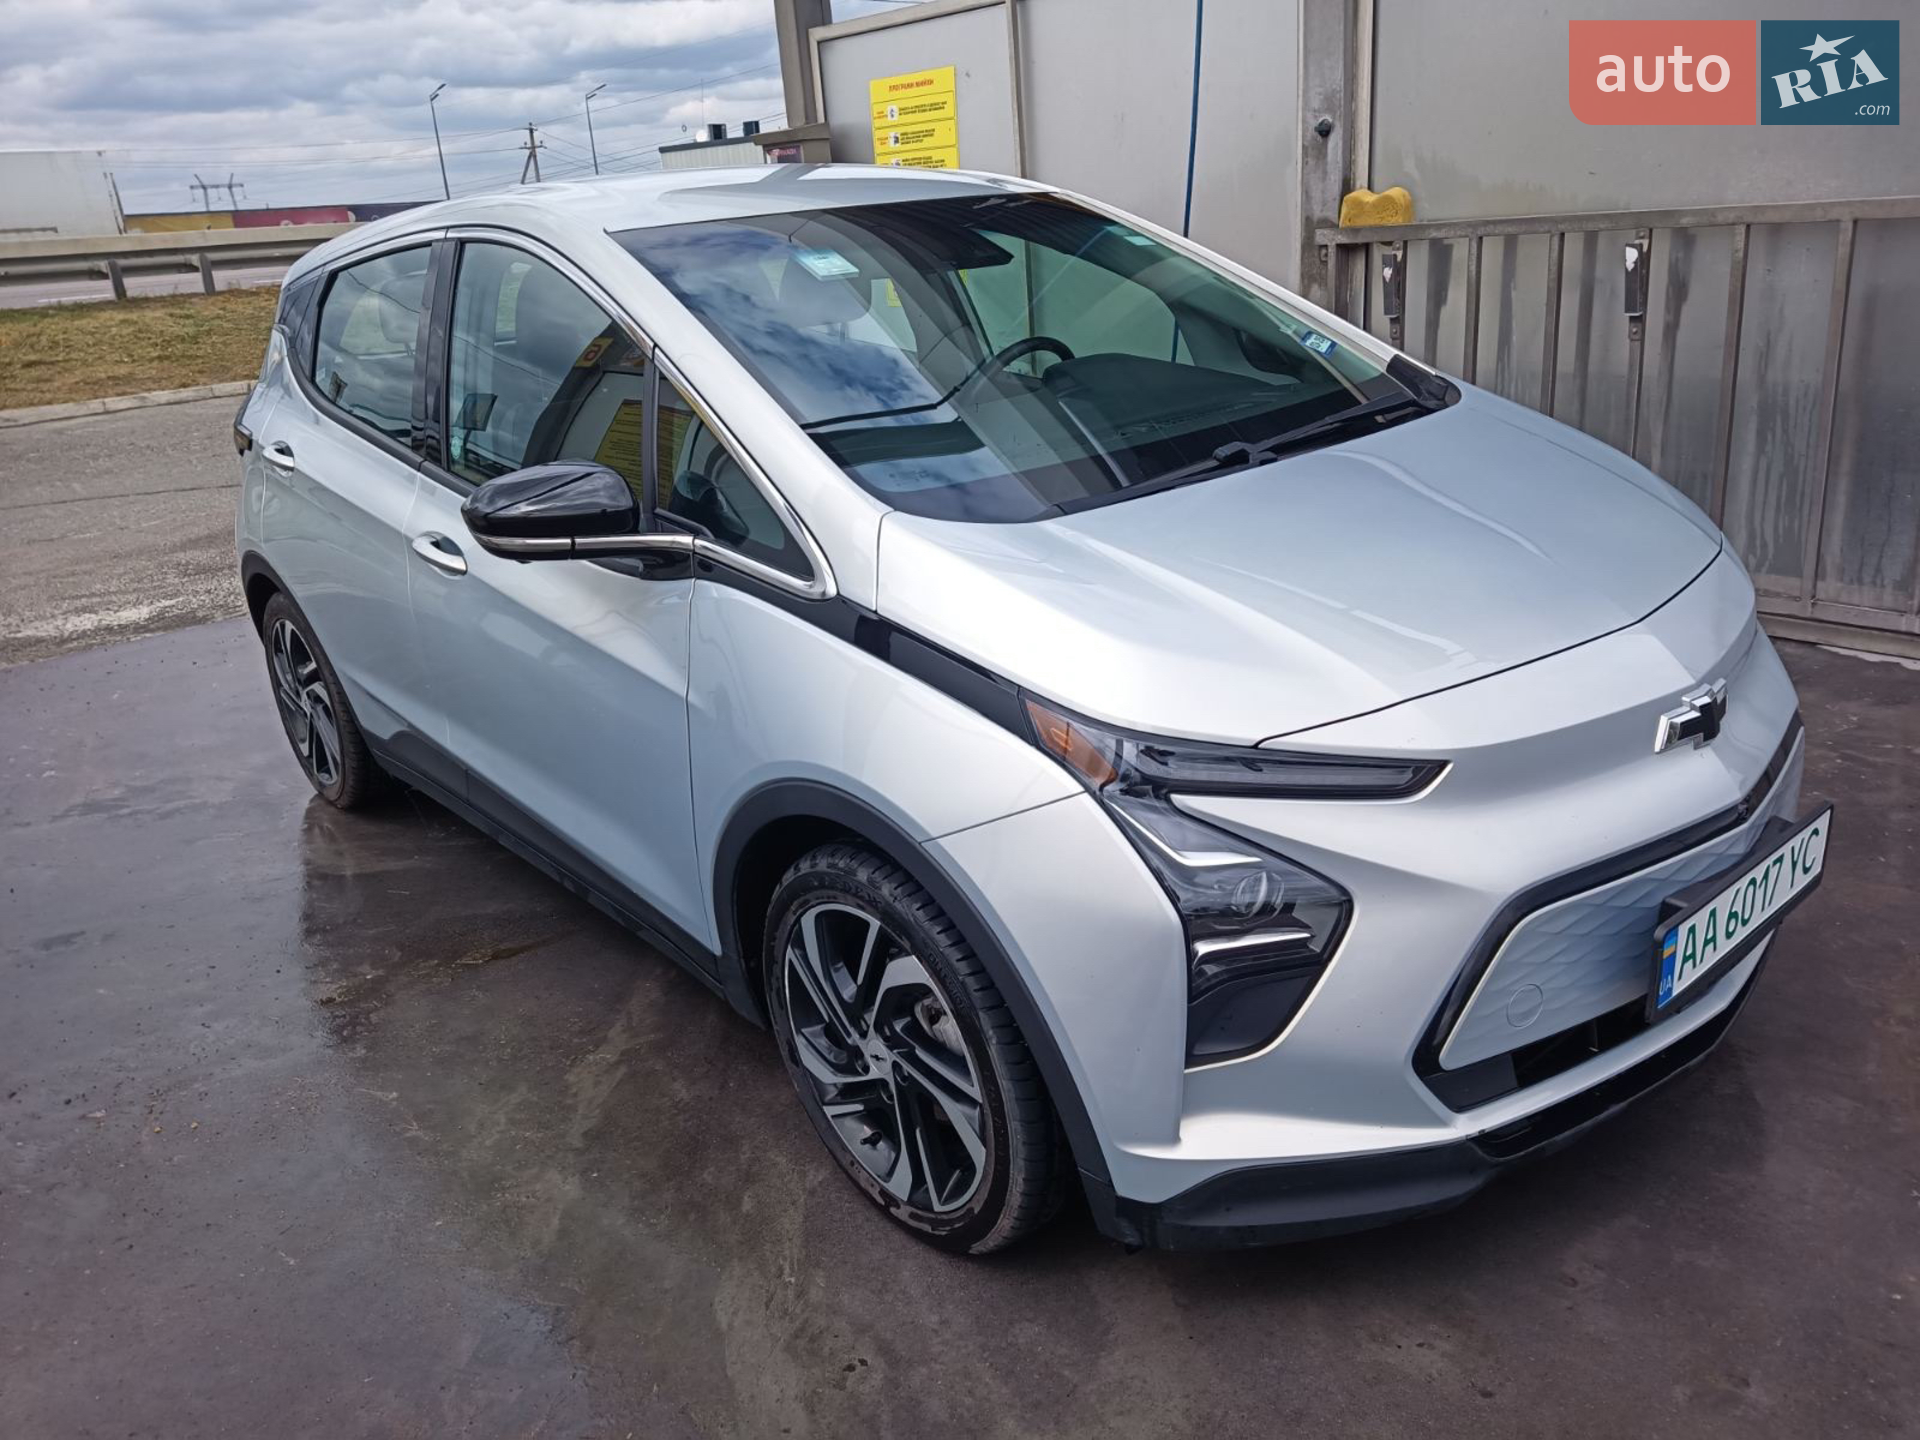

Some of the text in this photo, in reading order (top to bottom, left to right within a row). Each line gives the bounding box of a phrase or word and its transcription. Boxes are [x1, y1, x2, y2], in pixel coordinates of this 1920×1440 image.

[1677, 827, 1820, 982] AA 6017 YC
[1659, 974, 1672, 996] UA
